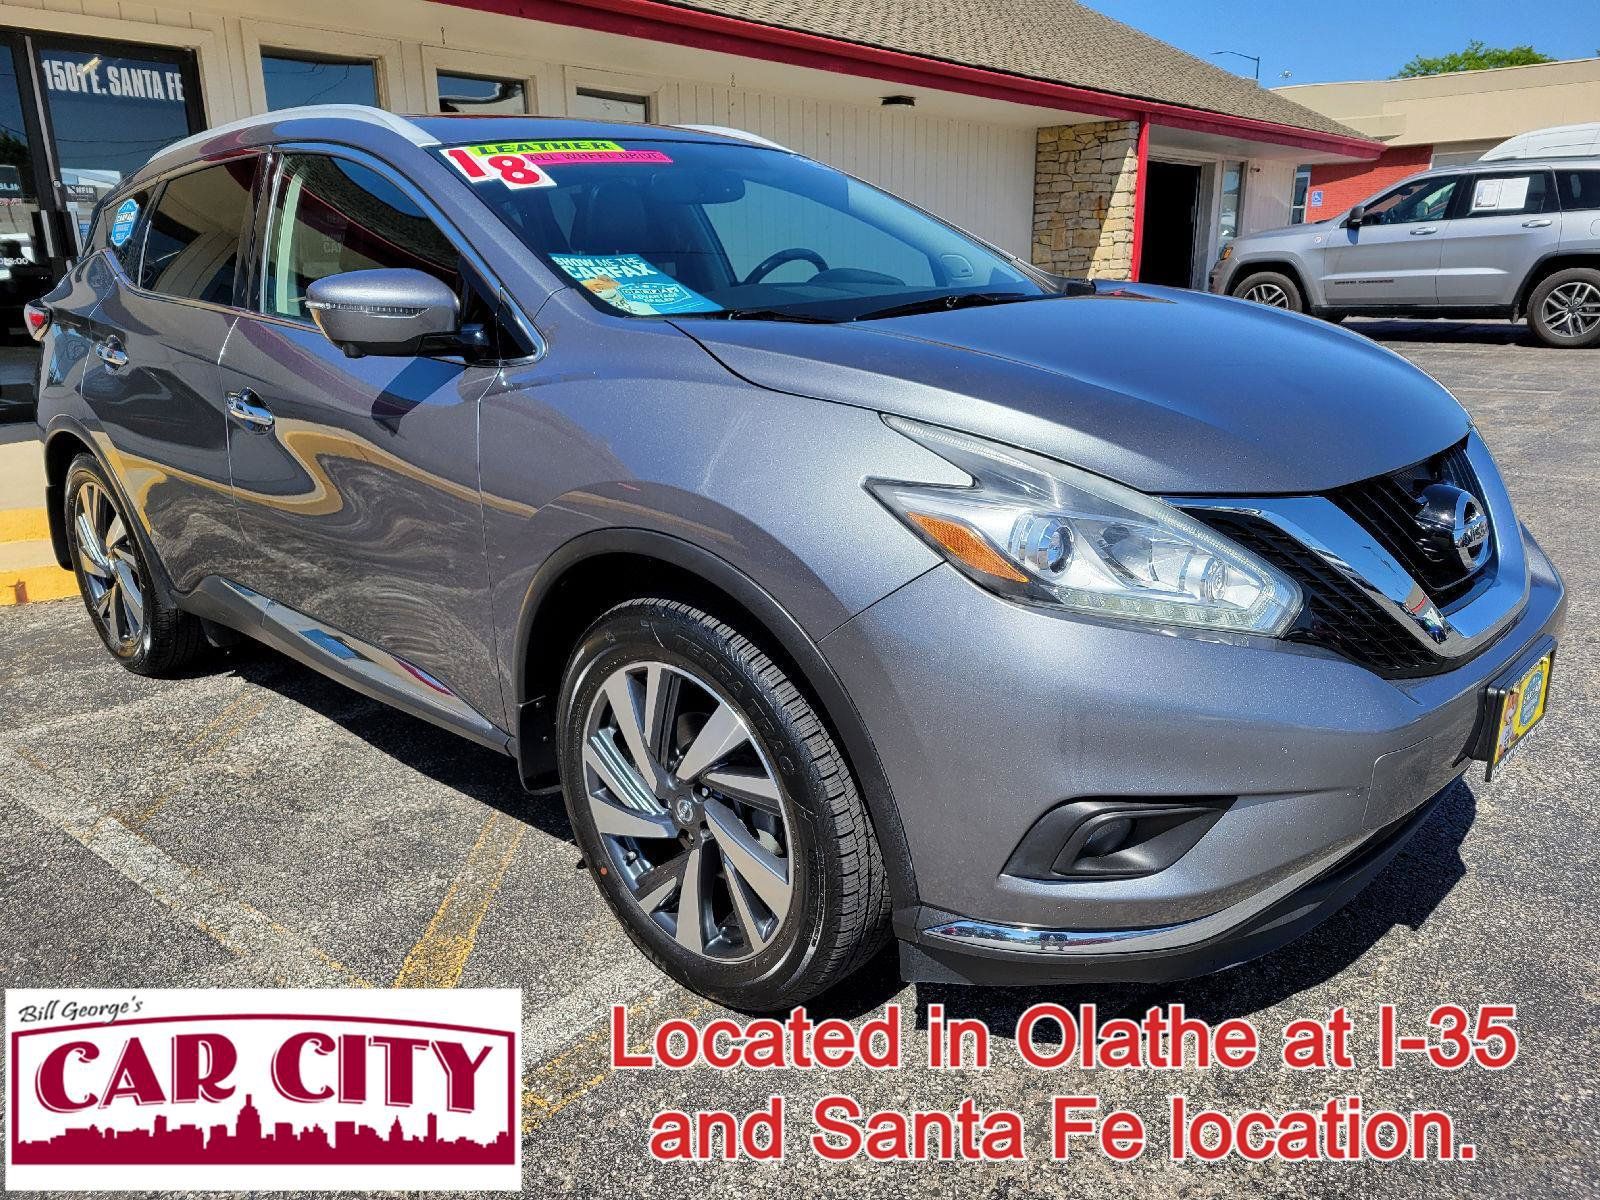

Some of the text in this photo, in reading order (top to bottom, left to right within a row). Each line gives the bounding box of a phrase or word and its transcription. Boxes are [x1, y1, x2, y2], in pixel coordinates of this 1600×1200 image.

[42, 59, 88, 93] 1501
[107, 66, 165, 100] SANTA
[165, 72, 186, 101] FE
[477, 140, 611, 155] LEATHER
[550, 256, 641, 267] SHOW ME THE
[560, 263, 659, 279] CARFAX
